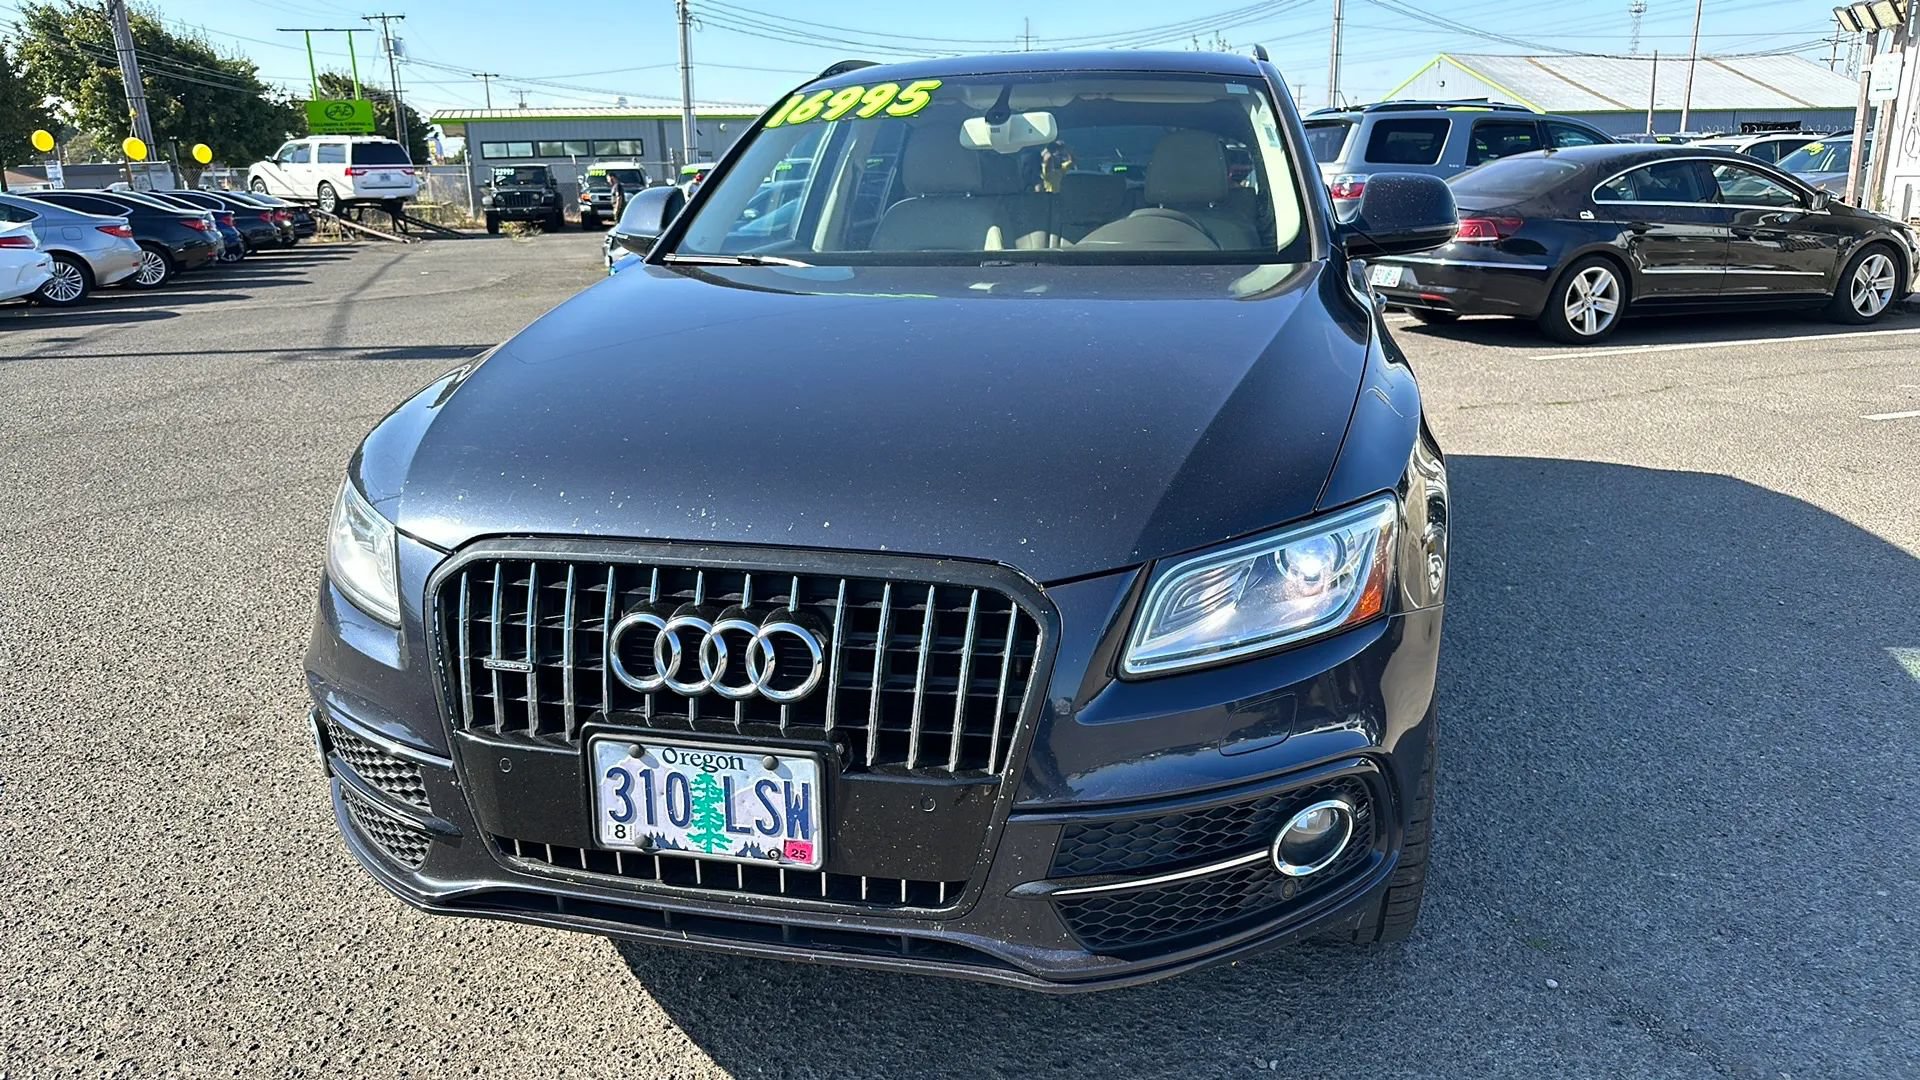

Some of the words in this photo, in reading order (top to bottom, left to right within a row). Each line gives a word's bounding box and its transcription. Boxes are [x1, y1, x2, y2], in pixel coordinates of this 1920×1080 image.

[765, 79, 943, 129] 16995
[662, 747, 746, 773] Oregon
[606, 766, 692, 828] 310
[723, 775, 811, 840] LSW
[614, 824, 627, 839] 8
[791, 848, 807, 860] 25
